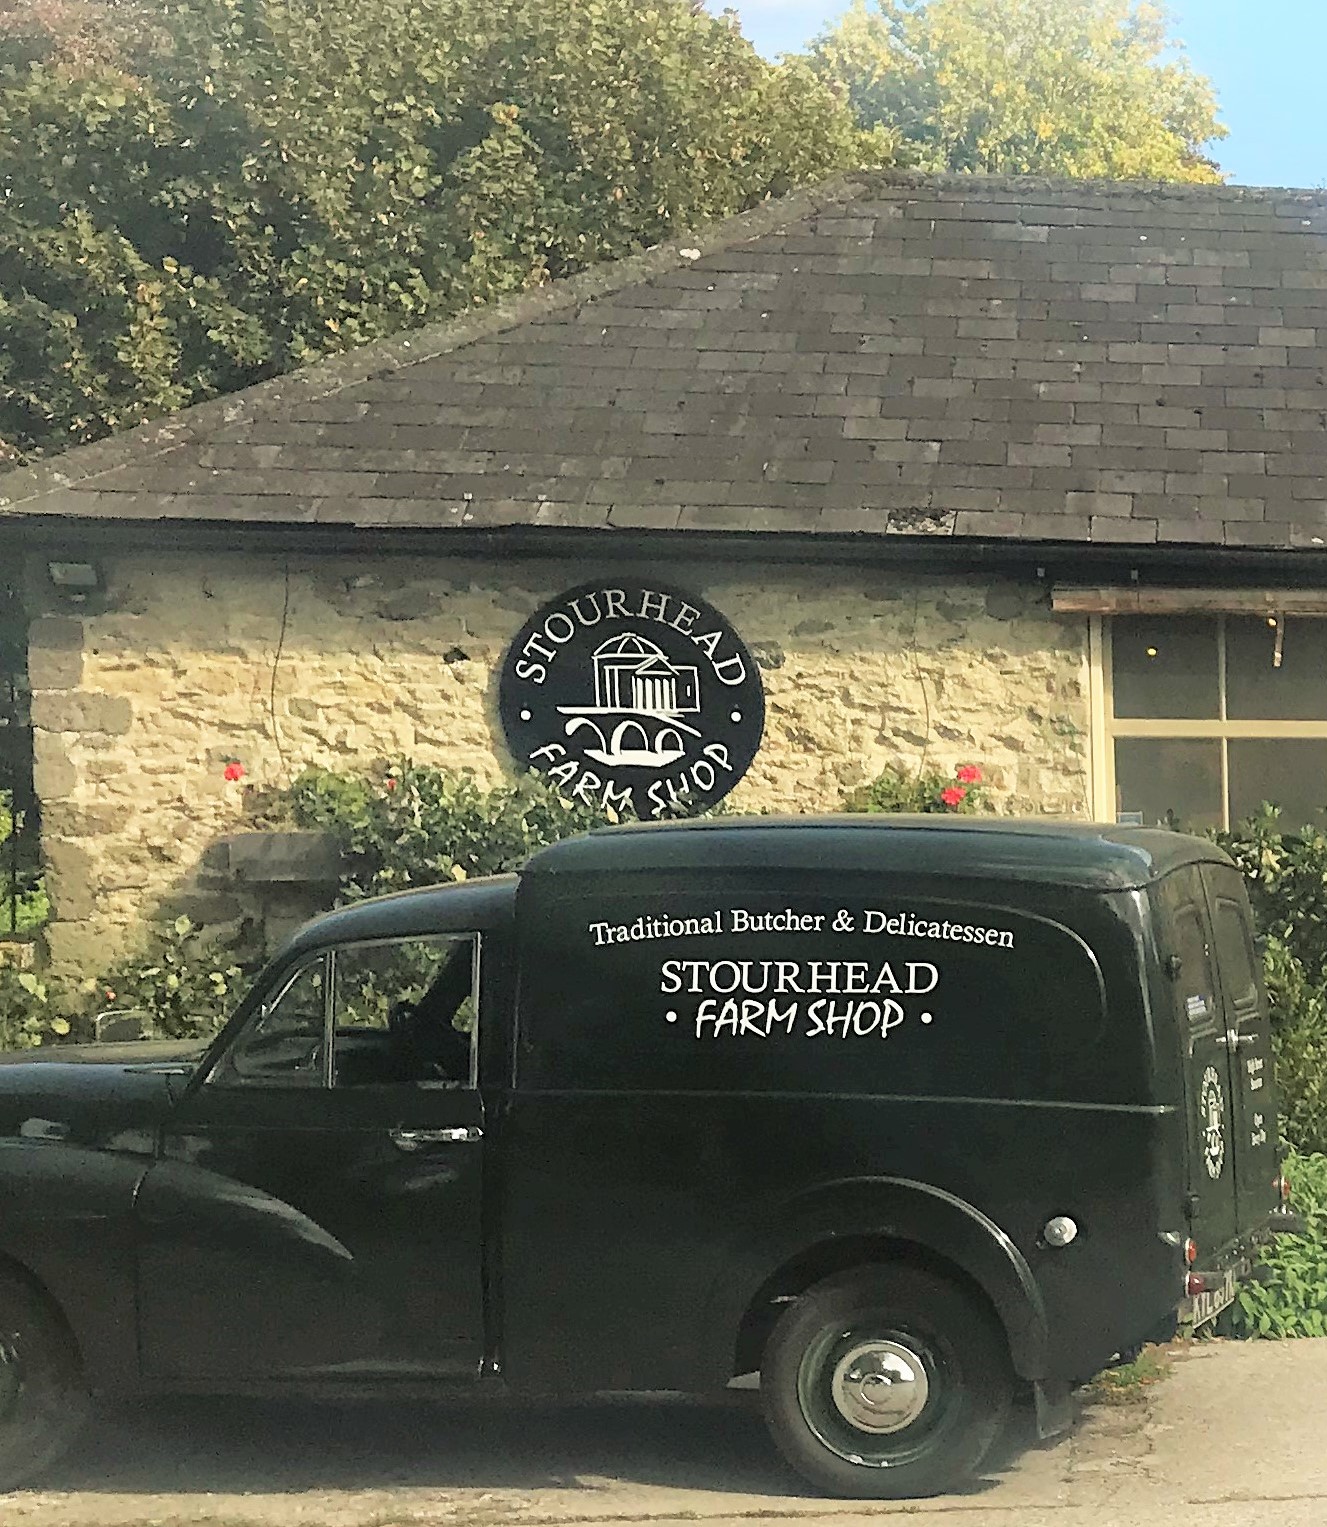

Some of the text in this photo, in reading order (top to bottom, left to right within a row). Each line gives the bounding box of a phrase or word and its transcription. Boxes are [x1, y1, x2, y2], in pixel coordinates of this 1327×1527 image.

[515, 588, 747, 687] STOURHEAD
[529, 743, 733, 816] FARM SHOP
[588, 908, 1015, 949] Traditional Butcher & Delicatessen
[660, 960, 939, 994] STOURHEAD
[695, 997, 904, 1039] FARM SHOP
